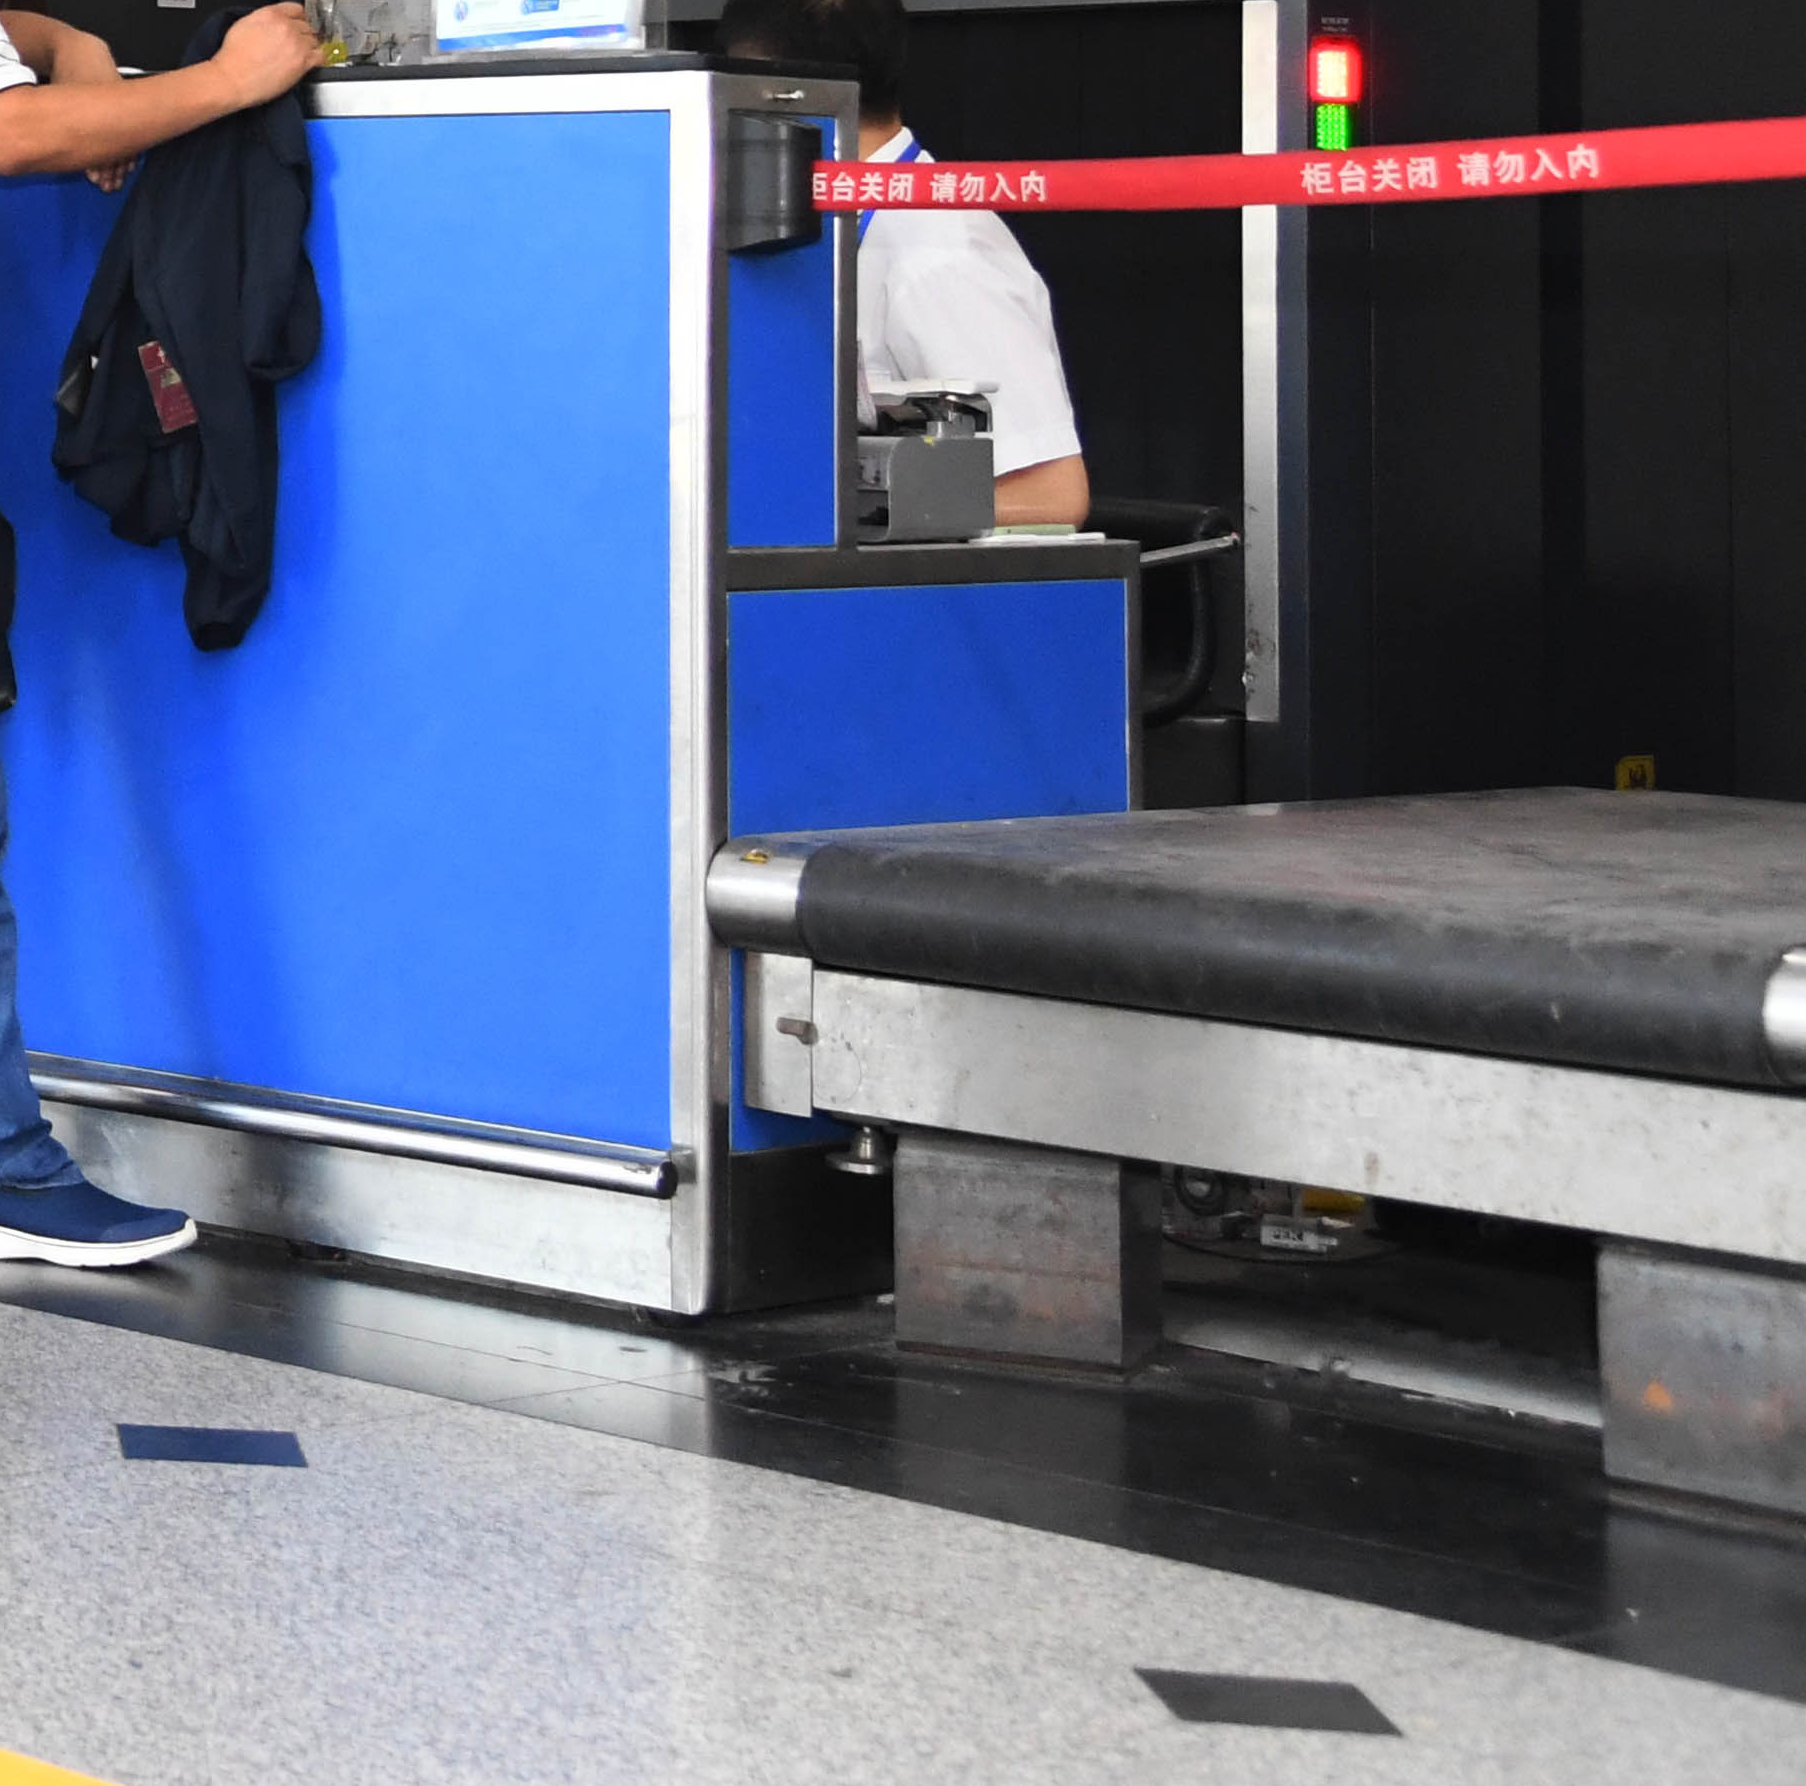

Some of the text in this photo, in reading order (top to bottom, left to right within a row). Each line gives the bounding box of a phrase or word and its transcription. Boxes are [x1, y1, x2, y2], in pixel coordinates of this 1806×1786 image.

[930, 171, 1047, 202] 请勿入内
[1301, 144, 1599, 194] 柜台关闭 请勿入内
